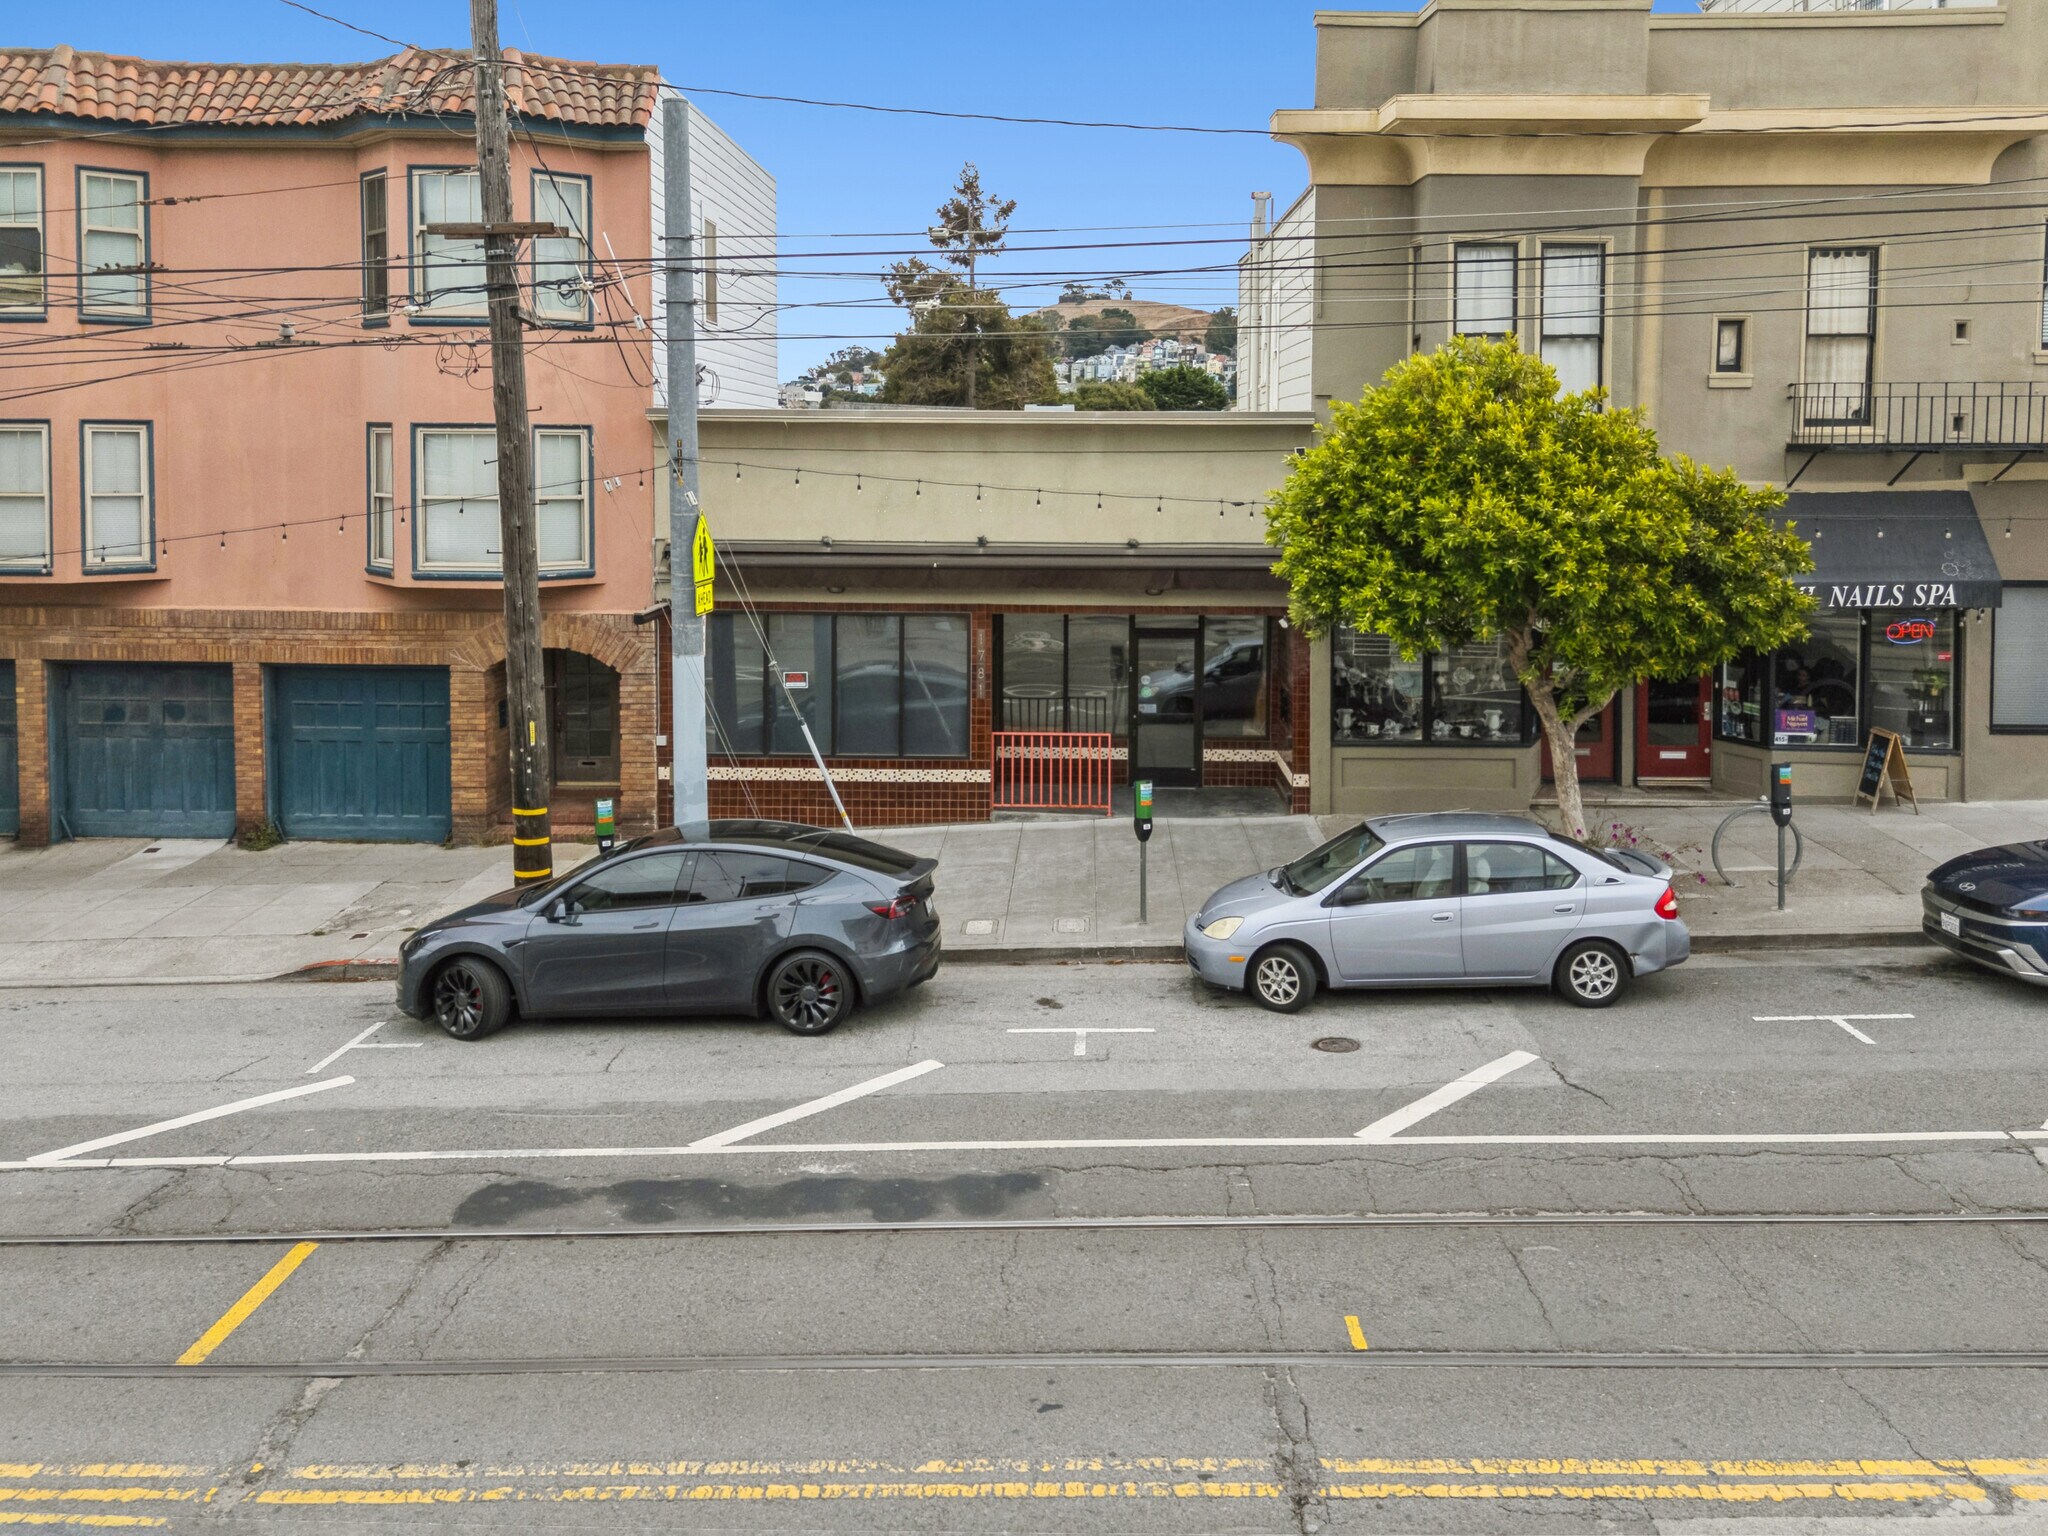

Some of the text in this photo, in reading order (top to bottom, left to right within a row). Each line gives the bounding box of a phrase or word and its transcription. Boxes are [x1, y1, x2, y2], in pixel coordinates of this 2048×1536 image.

[697, 590, 712, 605] AHEAD
[1828, 584, 1905, 607] NAILS
[1913, 583, 1957, 606] SPA
[1886, 623, 1934, 639] OPEN
[977, 633, 985, 697] 1781
